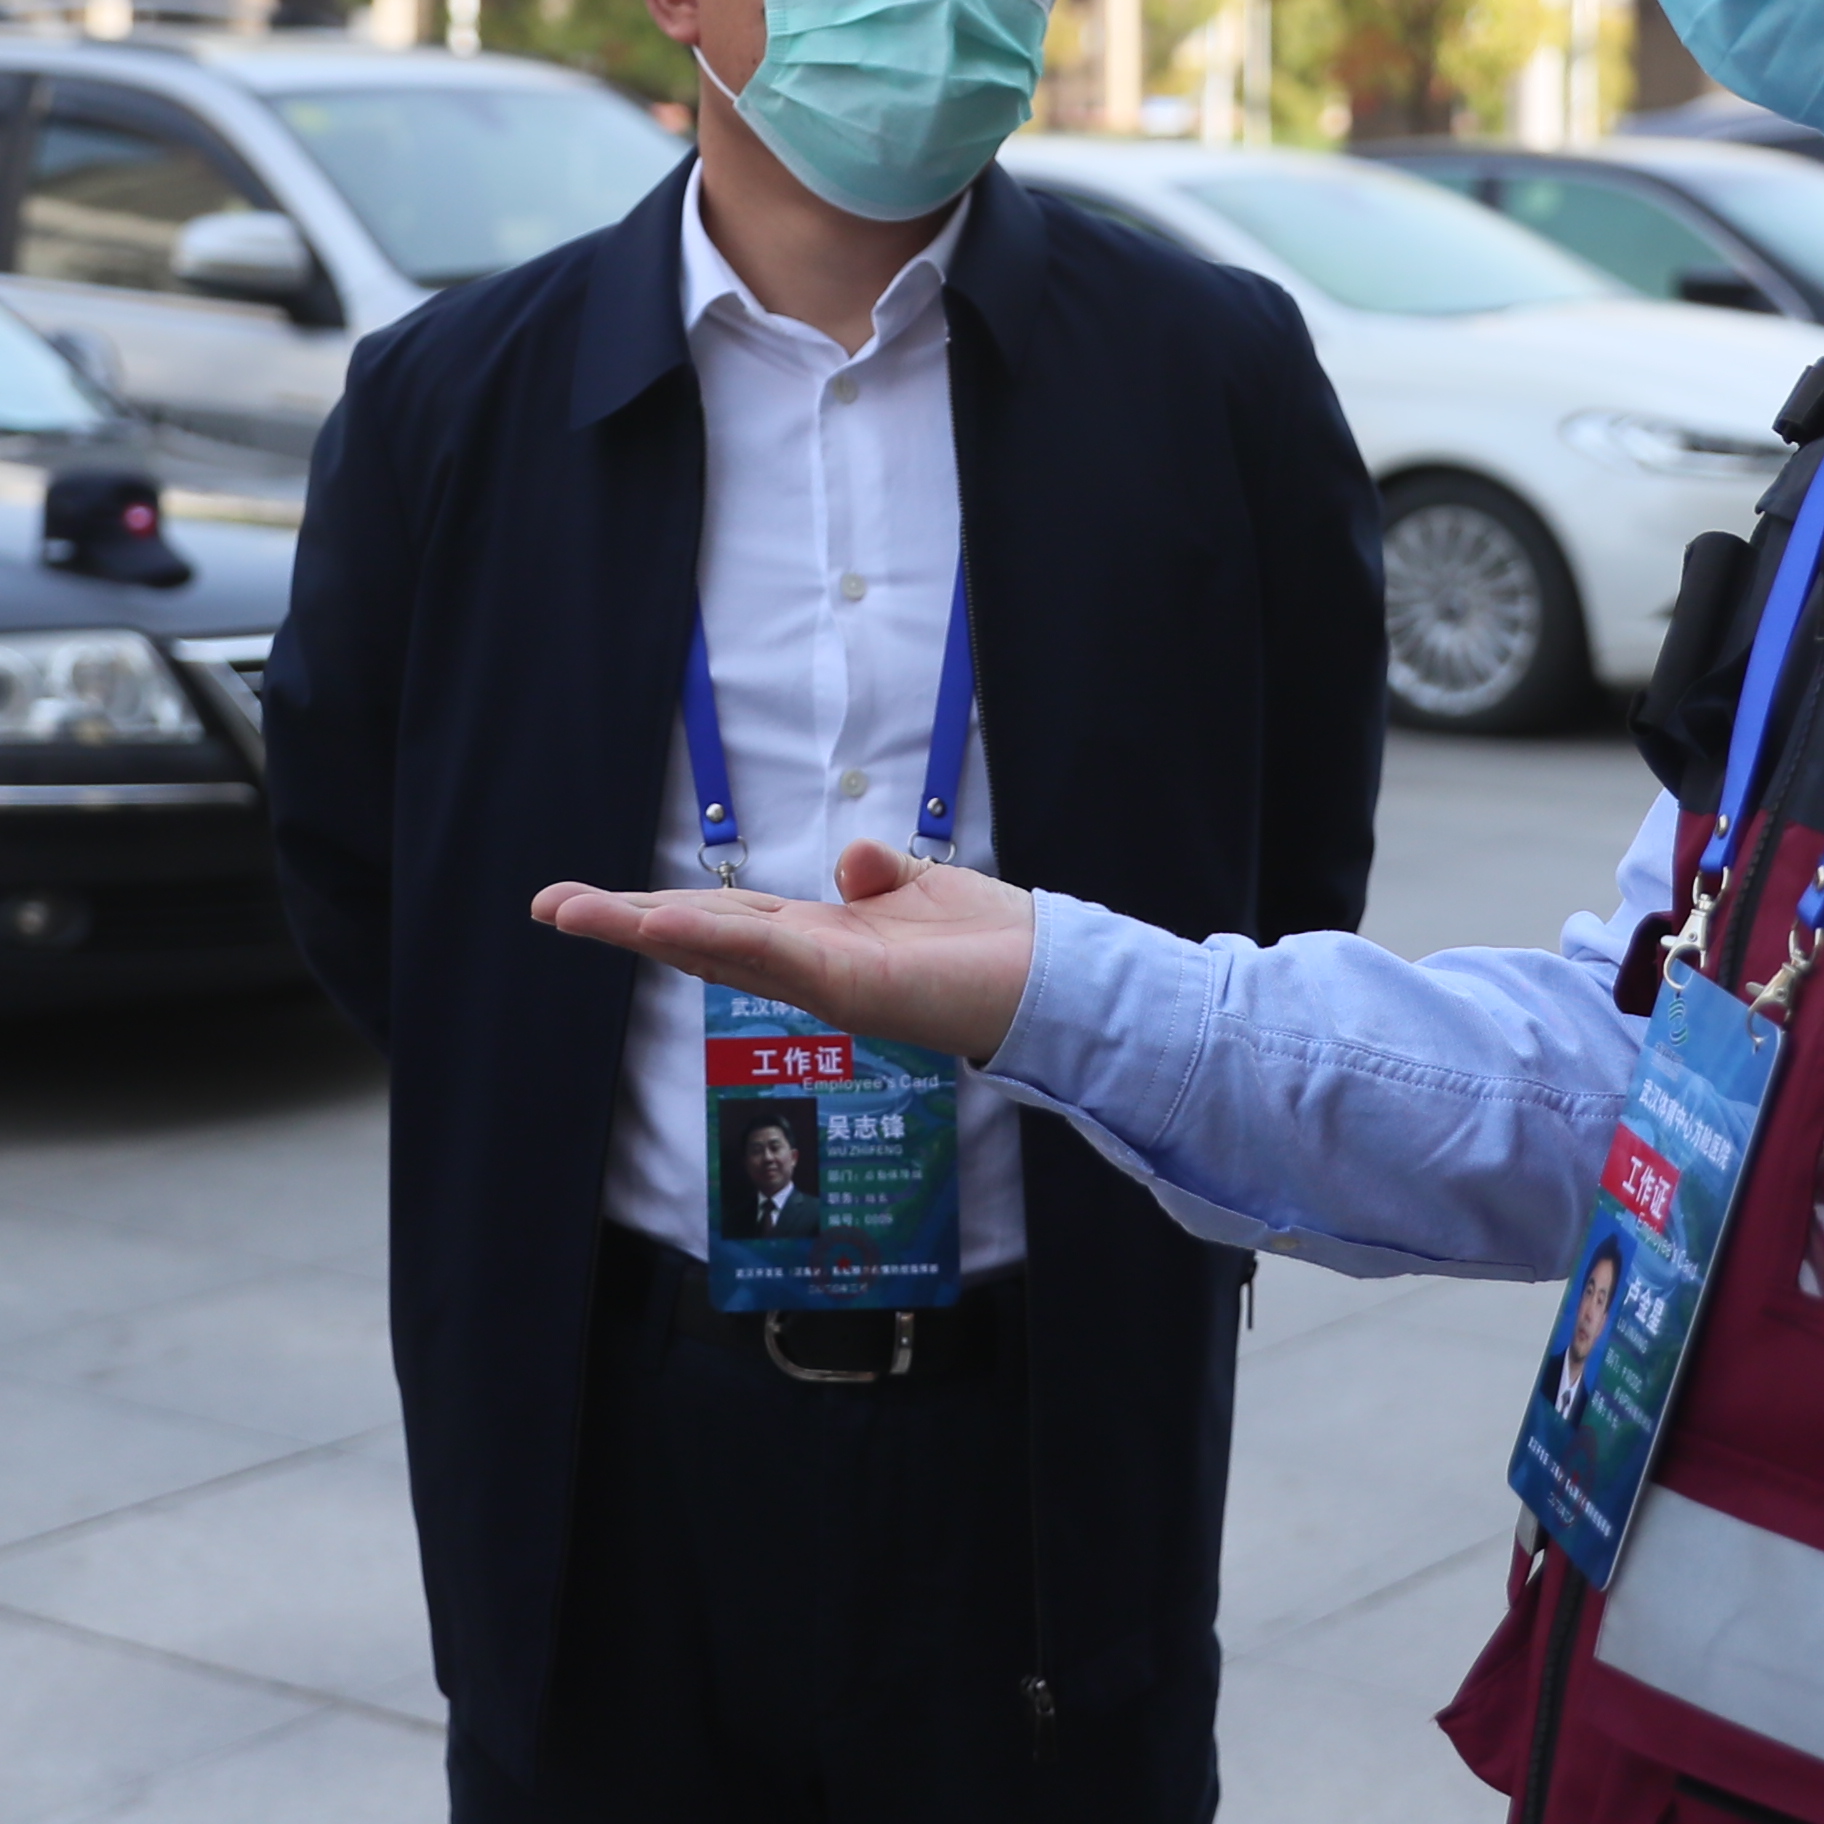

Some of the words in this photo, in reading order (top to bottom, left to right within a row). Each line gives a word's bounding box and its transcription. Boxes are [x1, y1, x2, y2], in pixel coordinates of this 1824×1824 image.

[751, 1046, 844, 1076] 工作证
[802, 1075, 896, 1093] Employee's
[899, 1073, 940, 1089] Card
[827, 1114, 905, 1140] 吴志锋
[1639, 1078, 1732, 1170] 武汉体育中心方舱医院
[1622, 1155, 1671, 1219] 工作证
[1677, 1248, 1699, 1281] Card
[1623, 1276, 1666, 1336] 卢金星
